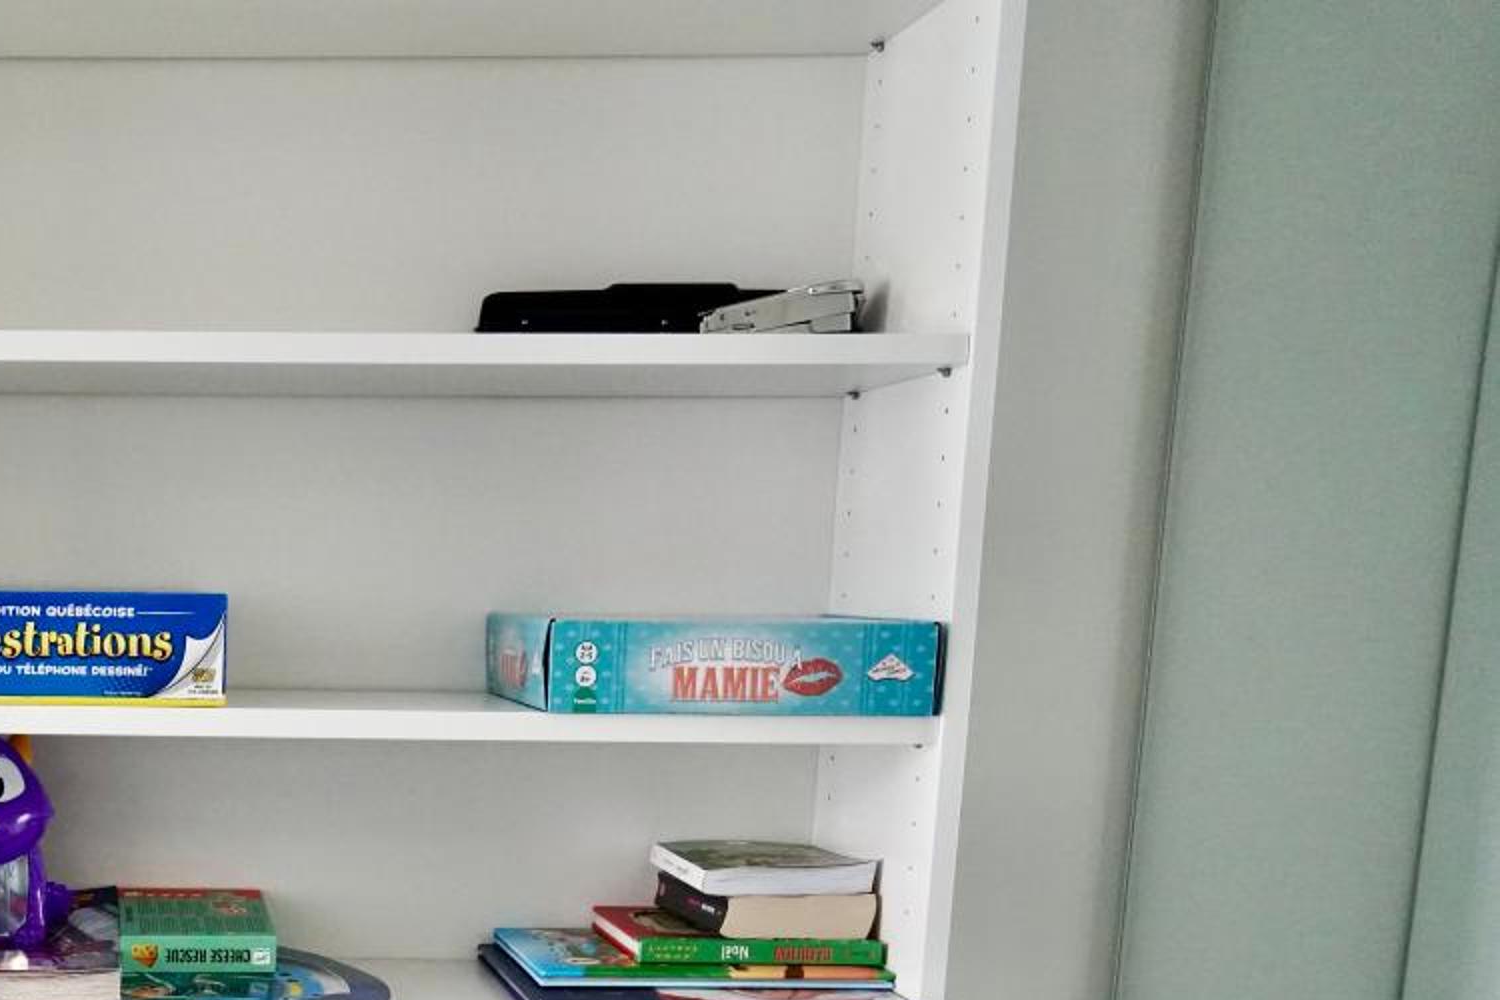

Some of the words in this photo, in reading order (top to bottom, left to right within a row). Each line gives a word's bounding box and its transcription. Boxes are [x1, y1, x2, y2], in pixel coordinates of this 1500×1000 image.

[45, 603, 135, 618] QUÉBÉCOISE
[651, 640, 694, 671] FAIS
[732, 639, 785, 663] BISOU
[15, 663, 87, 676] TÉLÉPHONE
[673, 666, 779, 702] MAMIE
[165, 948, 207, 963] RESCUE
[210, 948, 251, 963] CHEESE
[721, 943, 749, 960] Noël
